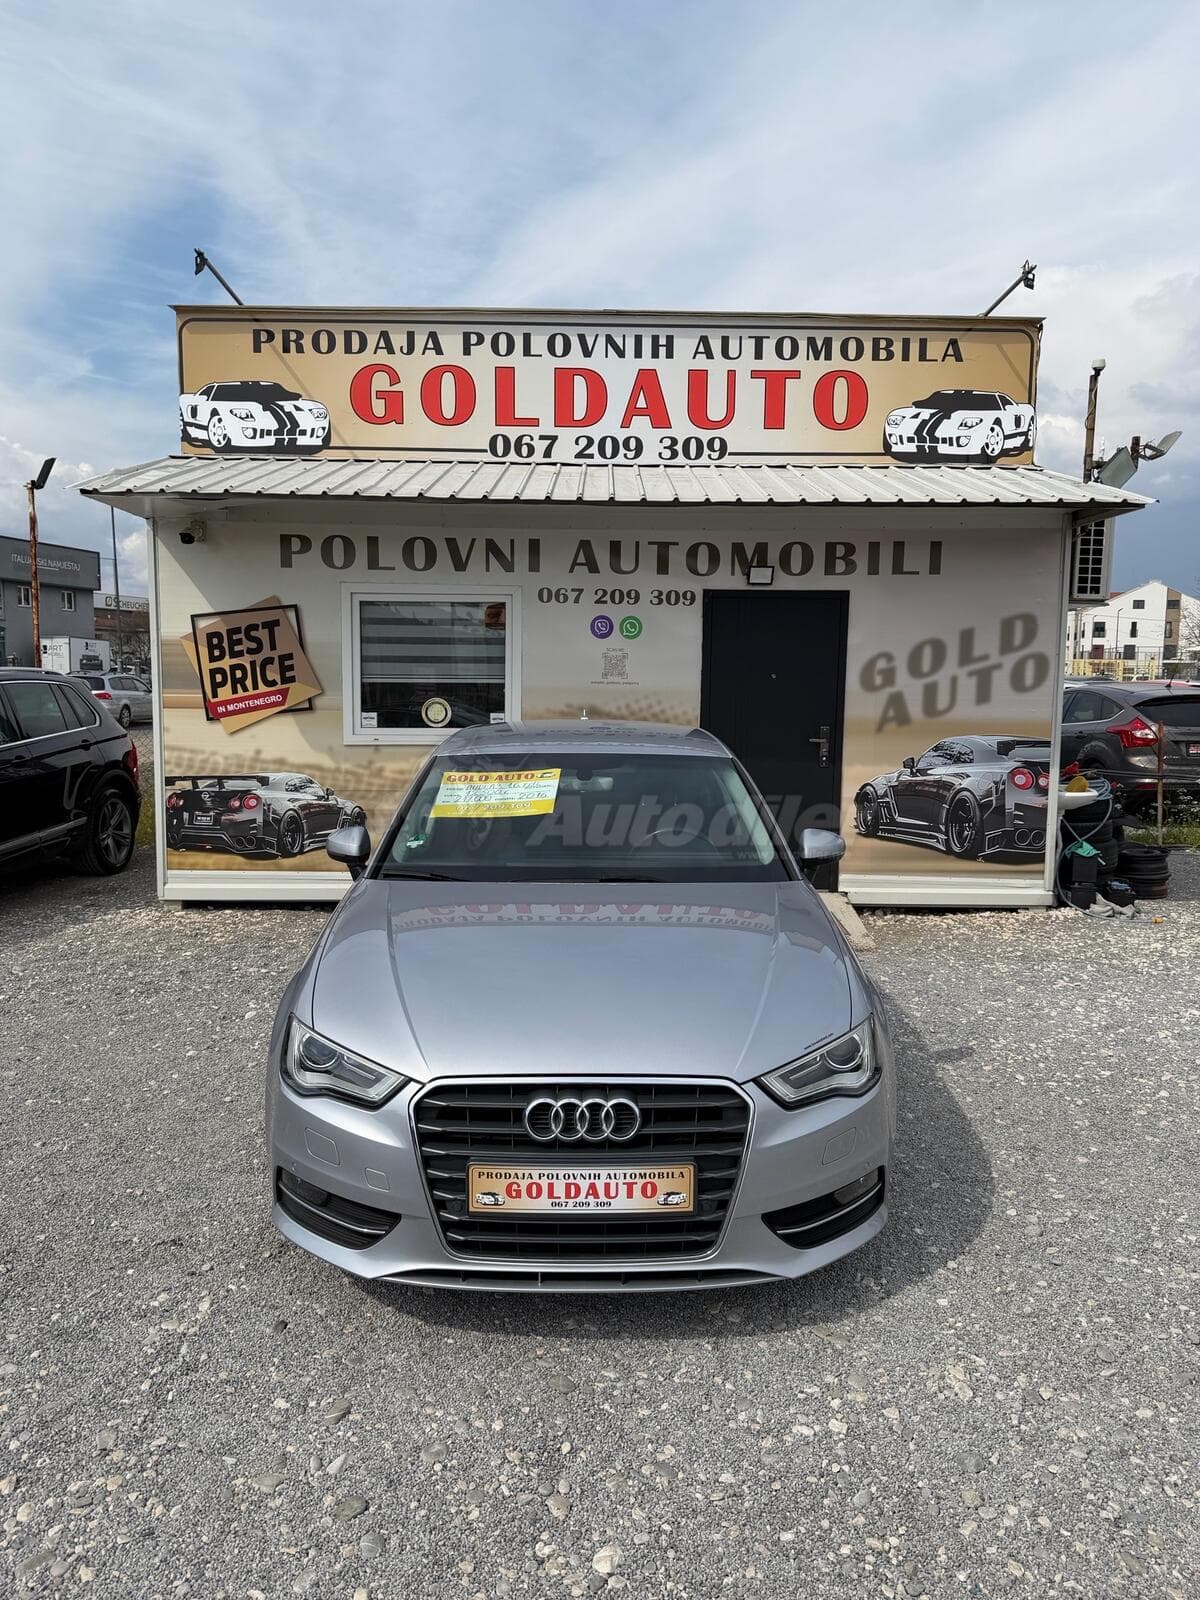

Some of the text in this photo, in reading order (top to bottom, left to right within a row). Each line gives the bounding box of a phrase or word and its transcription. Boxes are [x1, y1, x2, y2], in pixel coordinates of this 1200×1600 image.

[252, 328, 965, 363] PRODAJA POLOVNIH AUTOMOBILA
[349, 363, 870, 432] GOLDAUTO
[488, 433, 729, 462] 067 209 309
[279, 533, 944, 577] POLOVNI AUTOMOBILI
[537, 586, 696, 608] 067 209 309
[206, 618, 281, 664] BEST
[859, 612, 1039, 693] GOLD
[208, 652, 297, 699] PRICE
[875, 651, 1051, 734] AUTO
[217, 694, 283, 713] IN MONTENEGRO
[446, 772, 536, 783] GOLD AUTO
[478, 1171, 686, 1180] PRODAJA POLOVNIH AUTOMOBILA
[505, 1180, 659, 1200] GOLDAUTO
